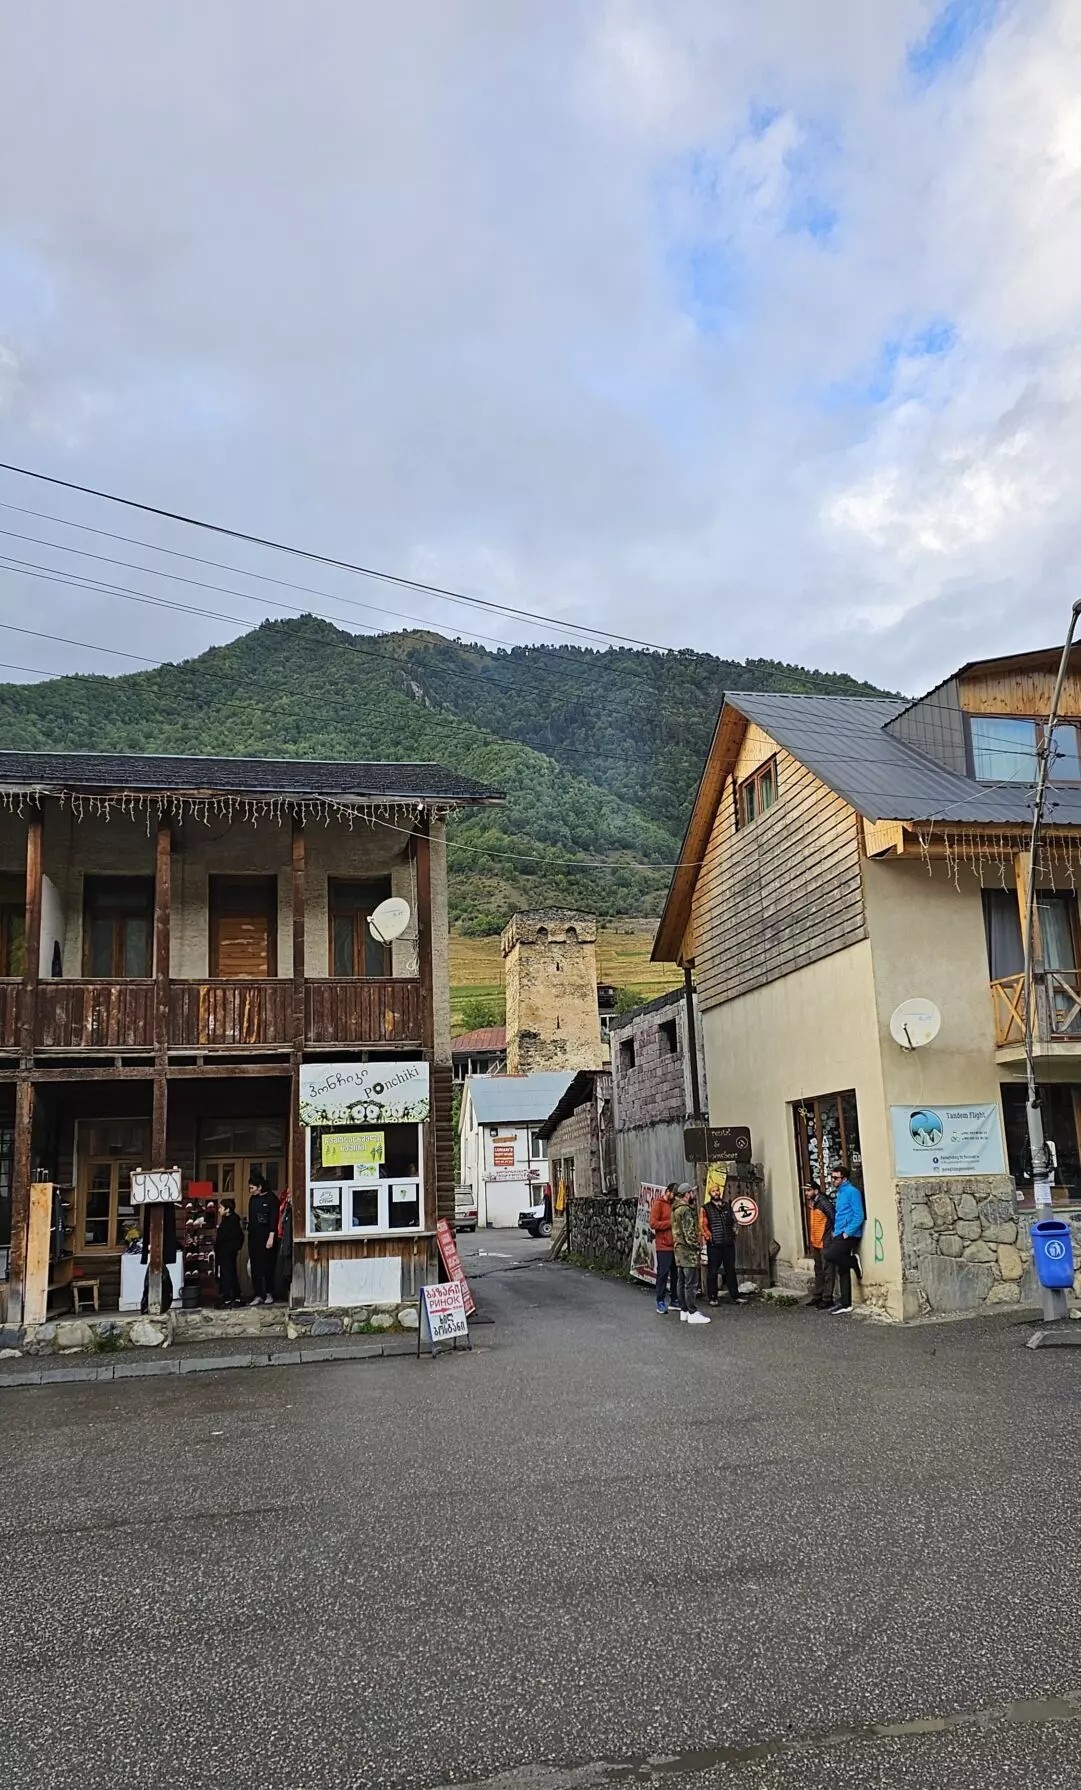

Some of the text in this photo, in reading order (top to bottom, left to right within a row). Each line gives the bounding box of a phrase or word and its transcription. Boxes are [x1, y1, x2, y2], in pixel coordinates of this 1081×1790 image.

[363, 1065, 420, 1099] Ponchiki
[969, 1111, 986, 1120] Flight
[429, 1295, 461, 1309] РИНОК
